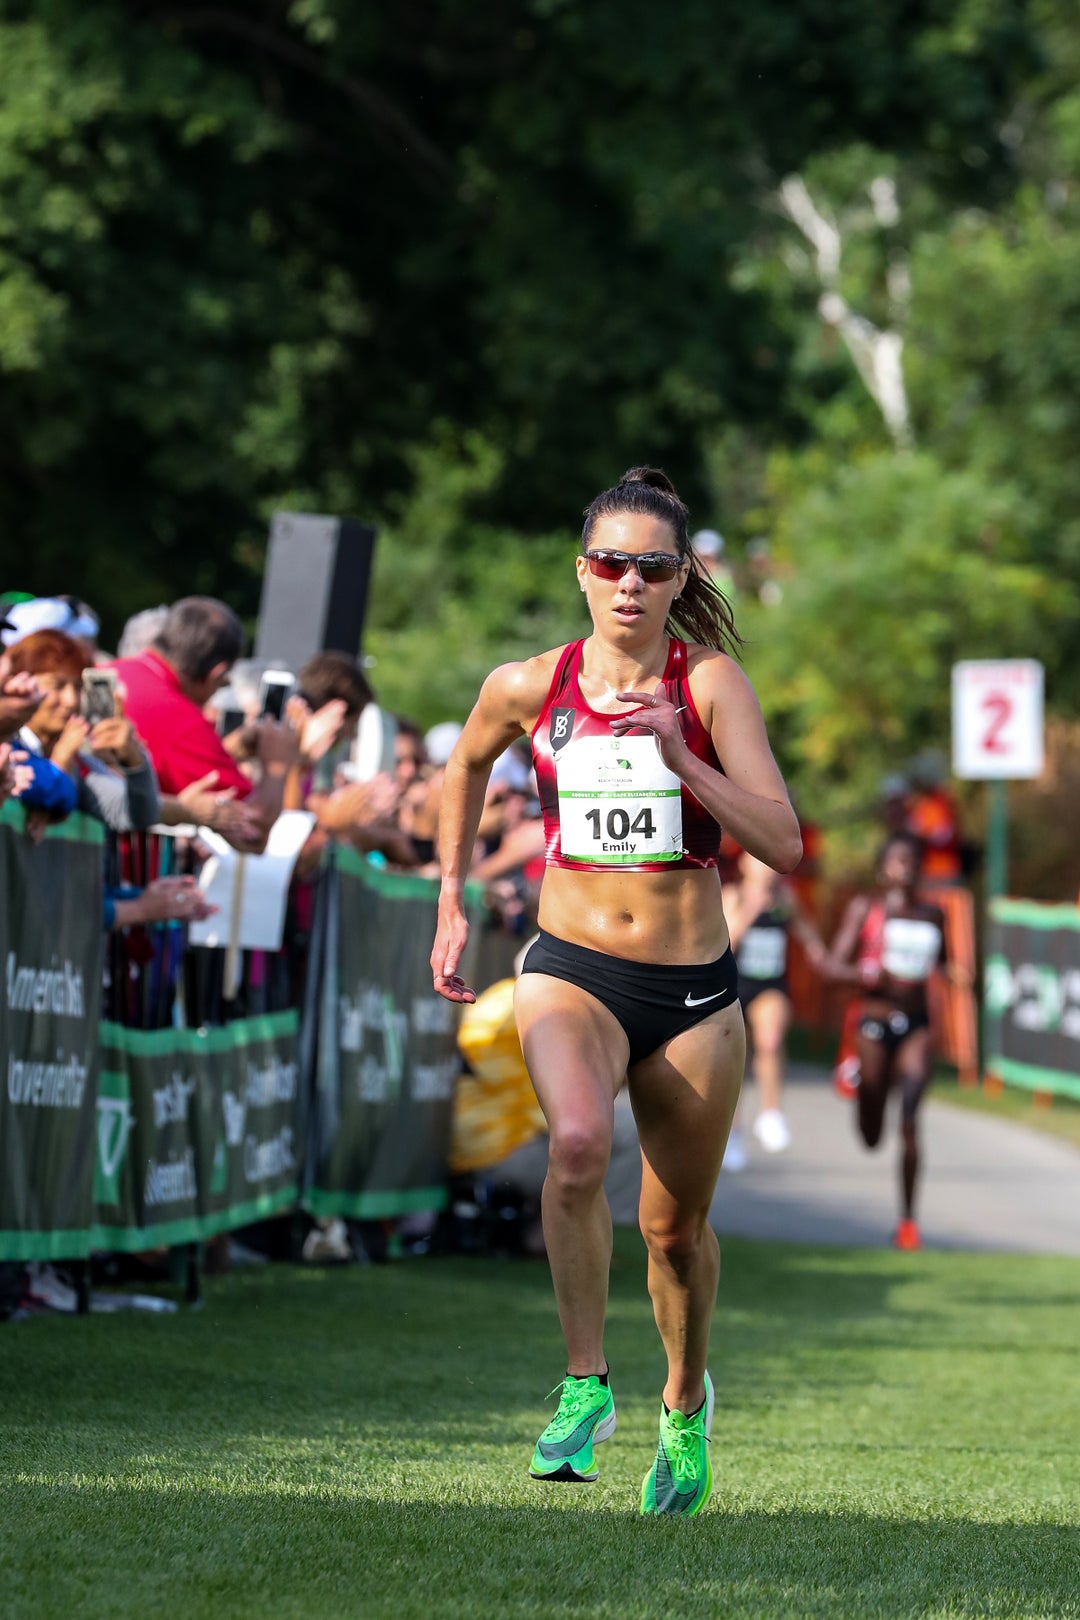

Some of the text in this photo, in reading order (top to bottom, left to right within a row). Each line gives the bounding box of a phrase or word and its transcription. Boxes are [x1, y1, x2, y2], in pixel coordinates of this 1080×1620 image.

[981, 688, 1014, 754] 2
[585, 808, 657, 840] 104
[602, 842, 636, 853] Emily
